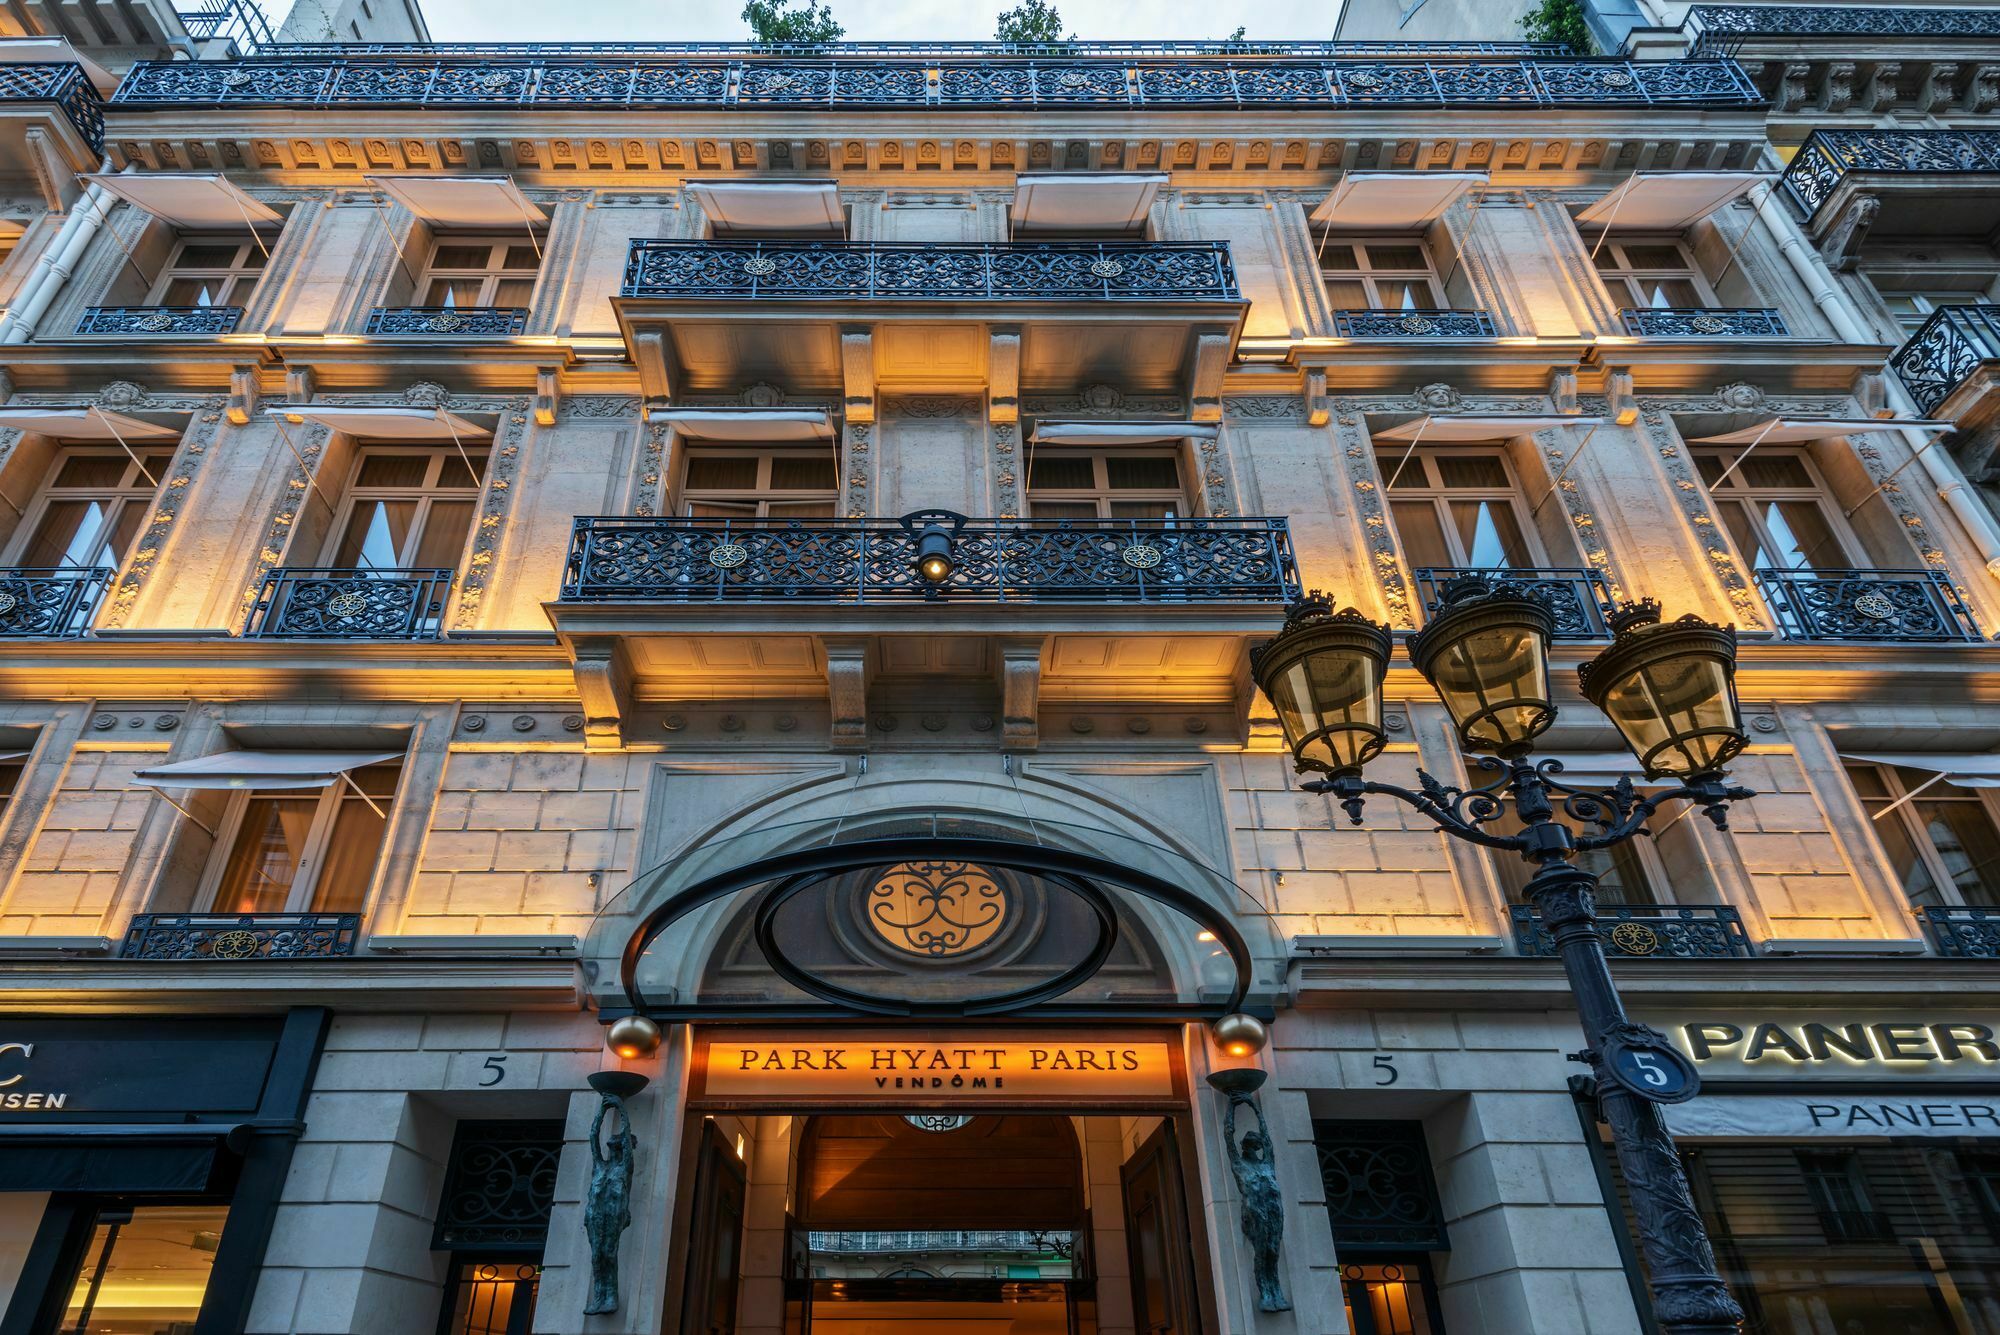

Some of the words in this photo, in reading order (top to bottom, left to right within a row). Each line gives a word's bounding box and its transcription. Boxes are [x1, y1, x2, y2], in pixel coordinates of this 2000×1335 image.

[1682, 1023, 2000, 1062] PANER
[478, 1056, 507, 1086] 5
[739, 1049, 847, 1070] PARK
[870, 1049, 1006, 1070] HYATT
[1030, 1049, 1139, 1070] PARIS
[1373, 1055, 1398, 1086] 5
[1633, 1052, 1668, 1086] 5
[875, 1074, 1003, 1088] VENDÔME
[1807, 1105, 2000, 1127] PANER
